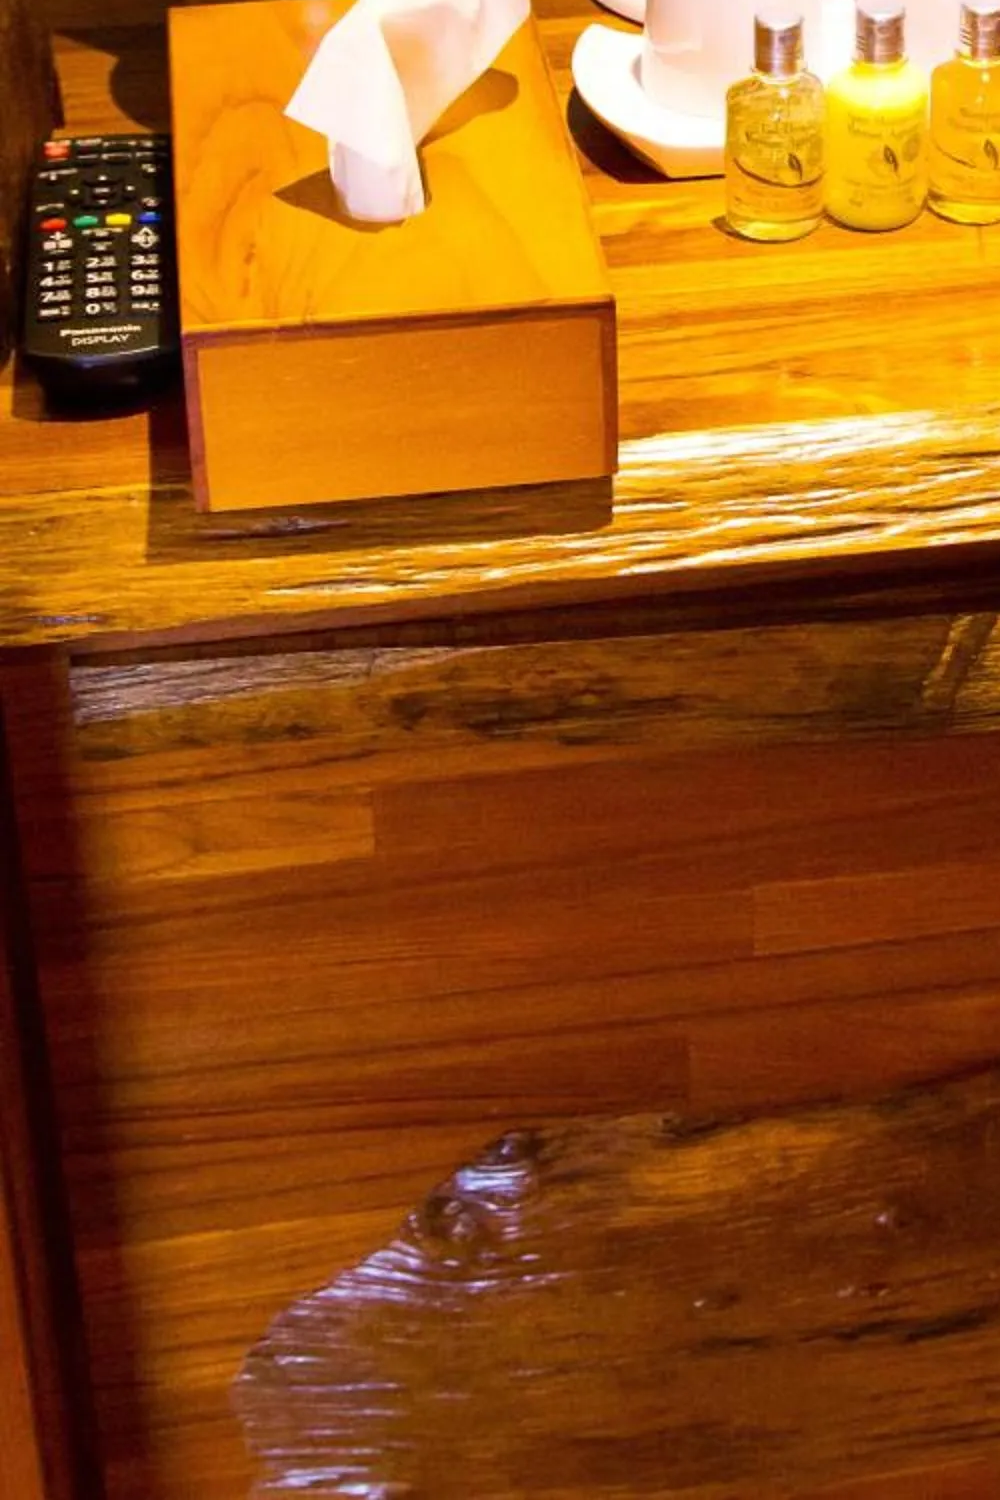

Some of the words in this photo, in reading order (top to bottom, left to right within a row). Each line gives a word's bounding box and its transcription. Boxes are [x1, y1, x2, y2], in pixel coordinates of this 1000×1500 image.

[43, 262, 54, 272] 1
[86, 257, 99, 268] 2
[131, 255, 145, 265] 3
[40, 276, 53, 287] 4
[86, 272, 99, 283] 5
[131, 270, 144, 280] 6
[40, 291, 54, 303] 7
[86, 288, 100, 298] 8
[131, 285, 145, 296] 9
[86, 303, 100, 314] 0
[72, 334, 130, 347] DISPLAY
